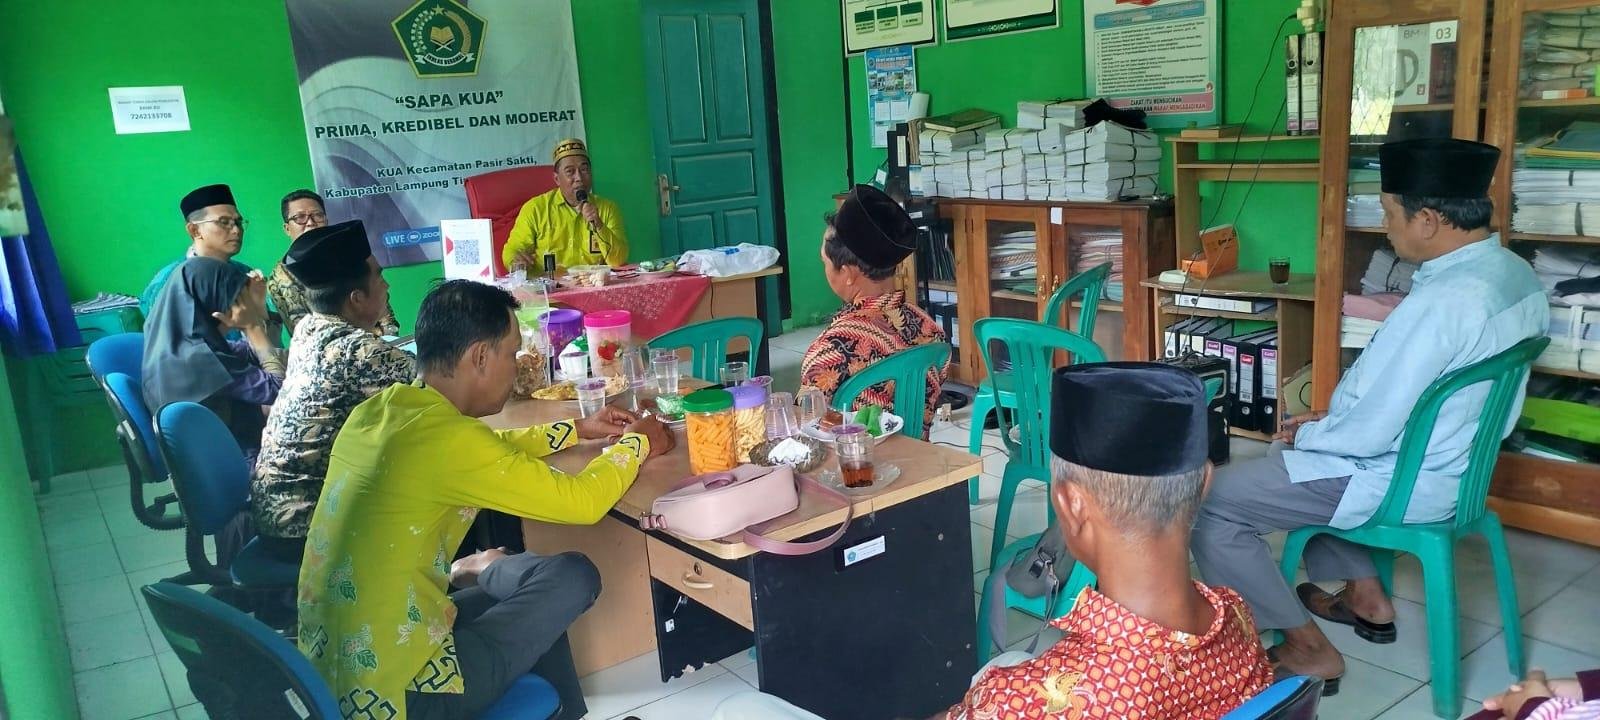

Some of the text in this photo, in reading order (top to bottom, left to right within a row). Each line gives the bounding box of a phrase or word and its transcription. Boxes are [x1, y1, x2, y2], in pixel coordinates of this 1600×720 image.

[1435, 27, 1452, 40] 03
[315, 110, 576, 139] PRIMA, KREDIBEL DAN MODERAT
[377, 155, 537, 178] KUA Kecamatan Pasir Sakti,
[325, 176, 466, 198] Kabupaten Lampung Ti
[385, 234, 406, 245] LIVE
